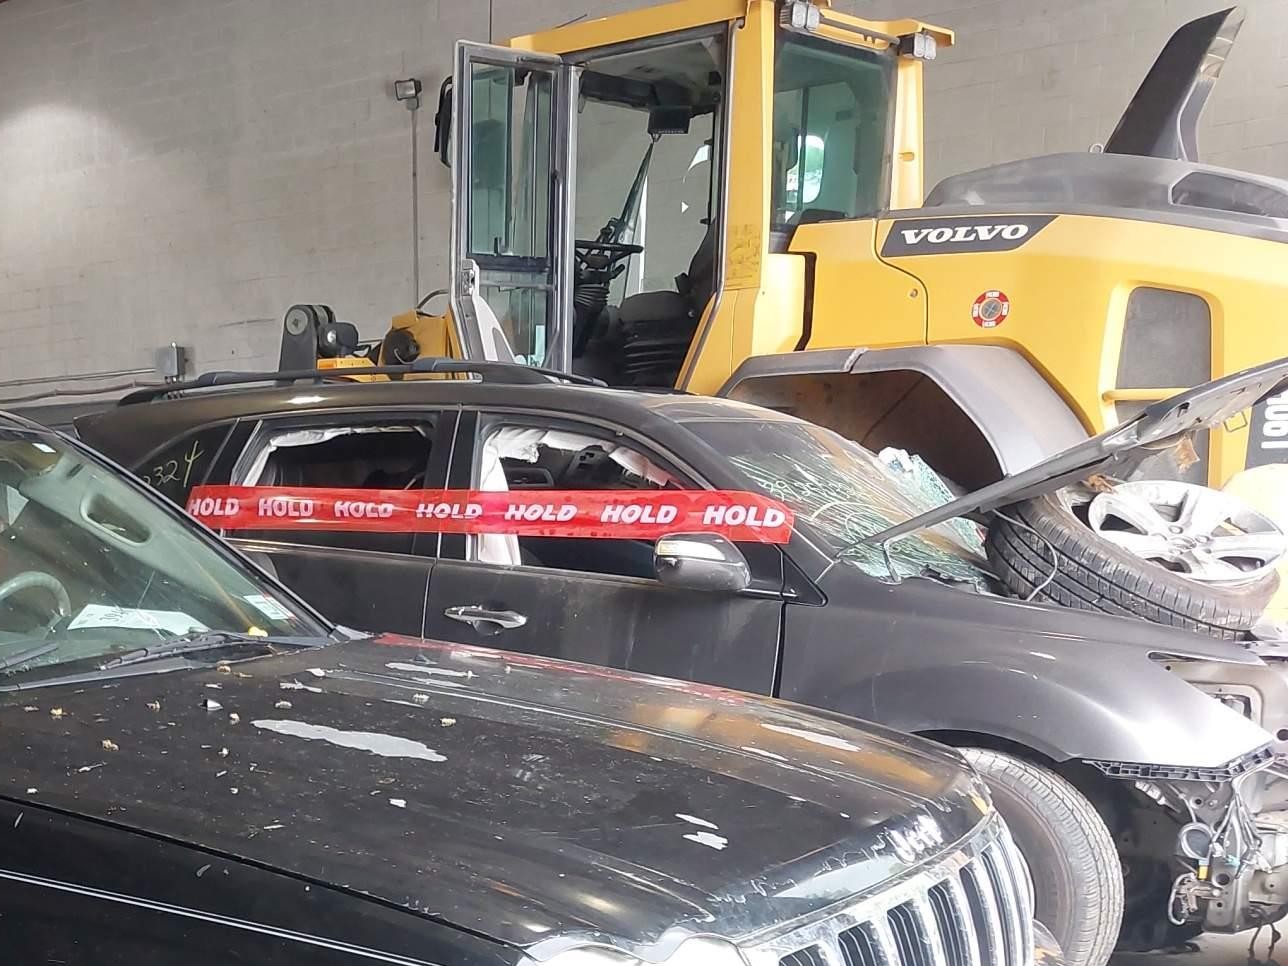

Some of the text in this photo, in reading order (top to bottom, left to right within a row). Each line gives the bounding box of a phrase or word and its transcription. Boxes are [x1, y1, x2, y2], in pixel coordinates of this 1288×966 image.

[901, 224, 1028, 245] VOLVO
[186, 497, 785, 528] HOLD HOLD HOLD HOLD HOLD HOLD HOLD
